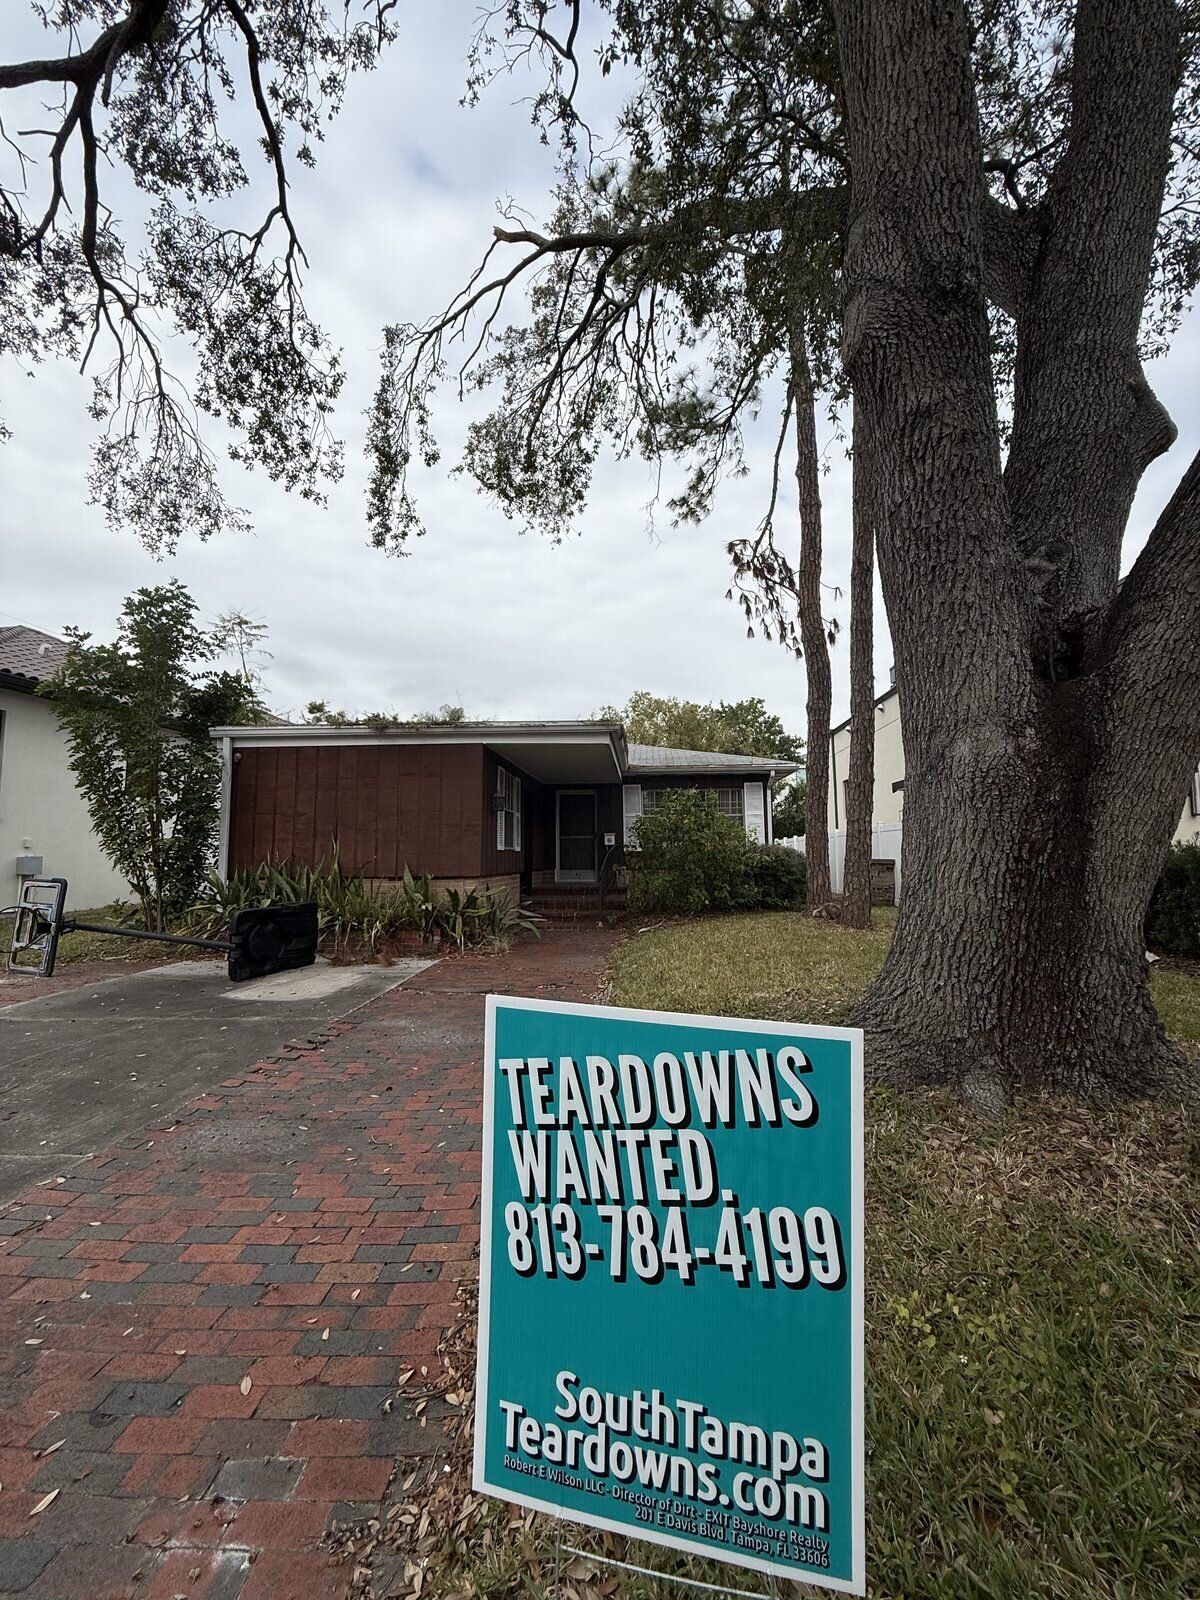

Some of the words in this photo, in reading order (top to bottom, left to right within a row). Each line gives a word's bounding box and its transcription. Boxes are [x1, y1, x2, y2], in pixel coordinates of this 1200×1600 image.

[499, 1046, 815, 1127] TEARDOWNS
[507, 1129, 737, 1205] WANTED.
[504, 1201, 843, 1287] 813-784-4199
[499, 1400, 826, 1530] Teardowns.com
[554, 1370, 826, 1481] SouthTampa
[503, 1454, 537, 1475] Robert
[539, 1465, 546, 1477] E
[549, 1468, 583, 1488] Wilson
[585, 1478, 605, 1494] LLC
[612, 1485, 657, 1507] Director
[659, 1497, 673, 1510] of
[674, 1500, 696, 1518] Dirt
[705, 1508, 730, 1526] EXIT
[733, 1516, 787, 1541] Bayshore
[790, 1529, 828, 1553] Realty
[635, 1505, 654, 1522] 201
[657, 1511, 664, 1525] E
[667, 1514, 697, 1534] Davis
[700, 1522, 728, 1541] Blvd.
[731, 1530, 773, 1554] Tampa,
[776, 1542, 790, 1558] FL
[793, 1546, 829, 1567] 33606
